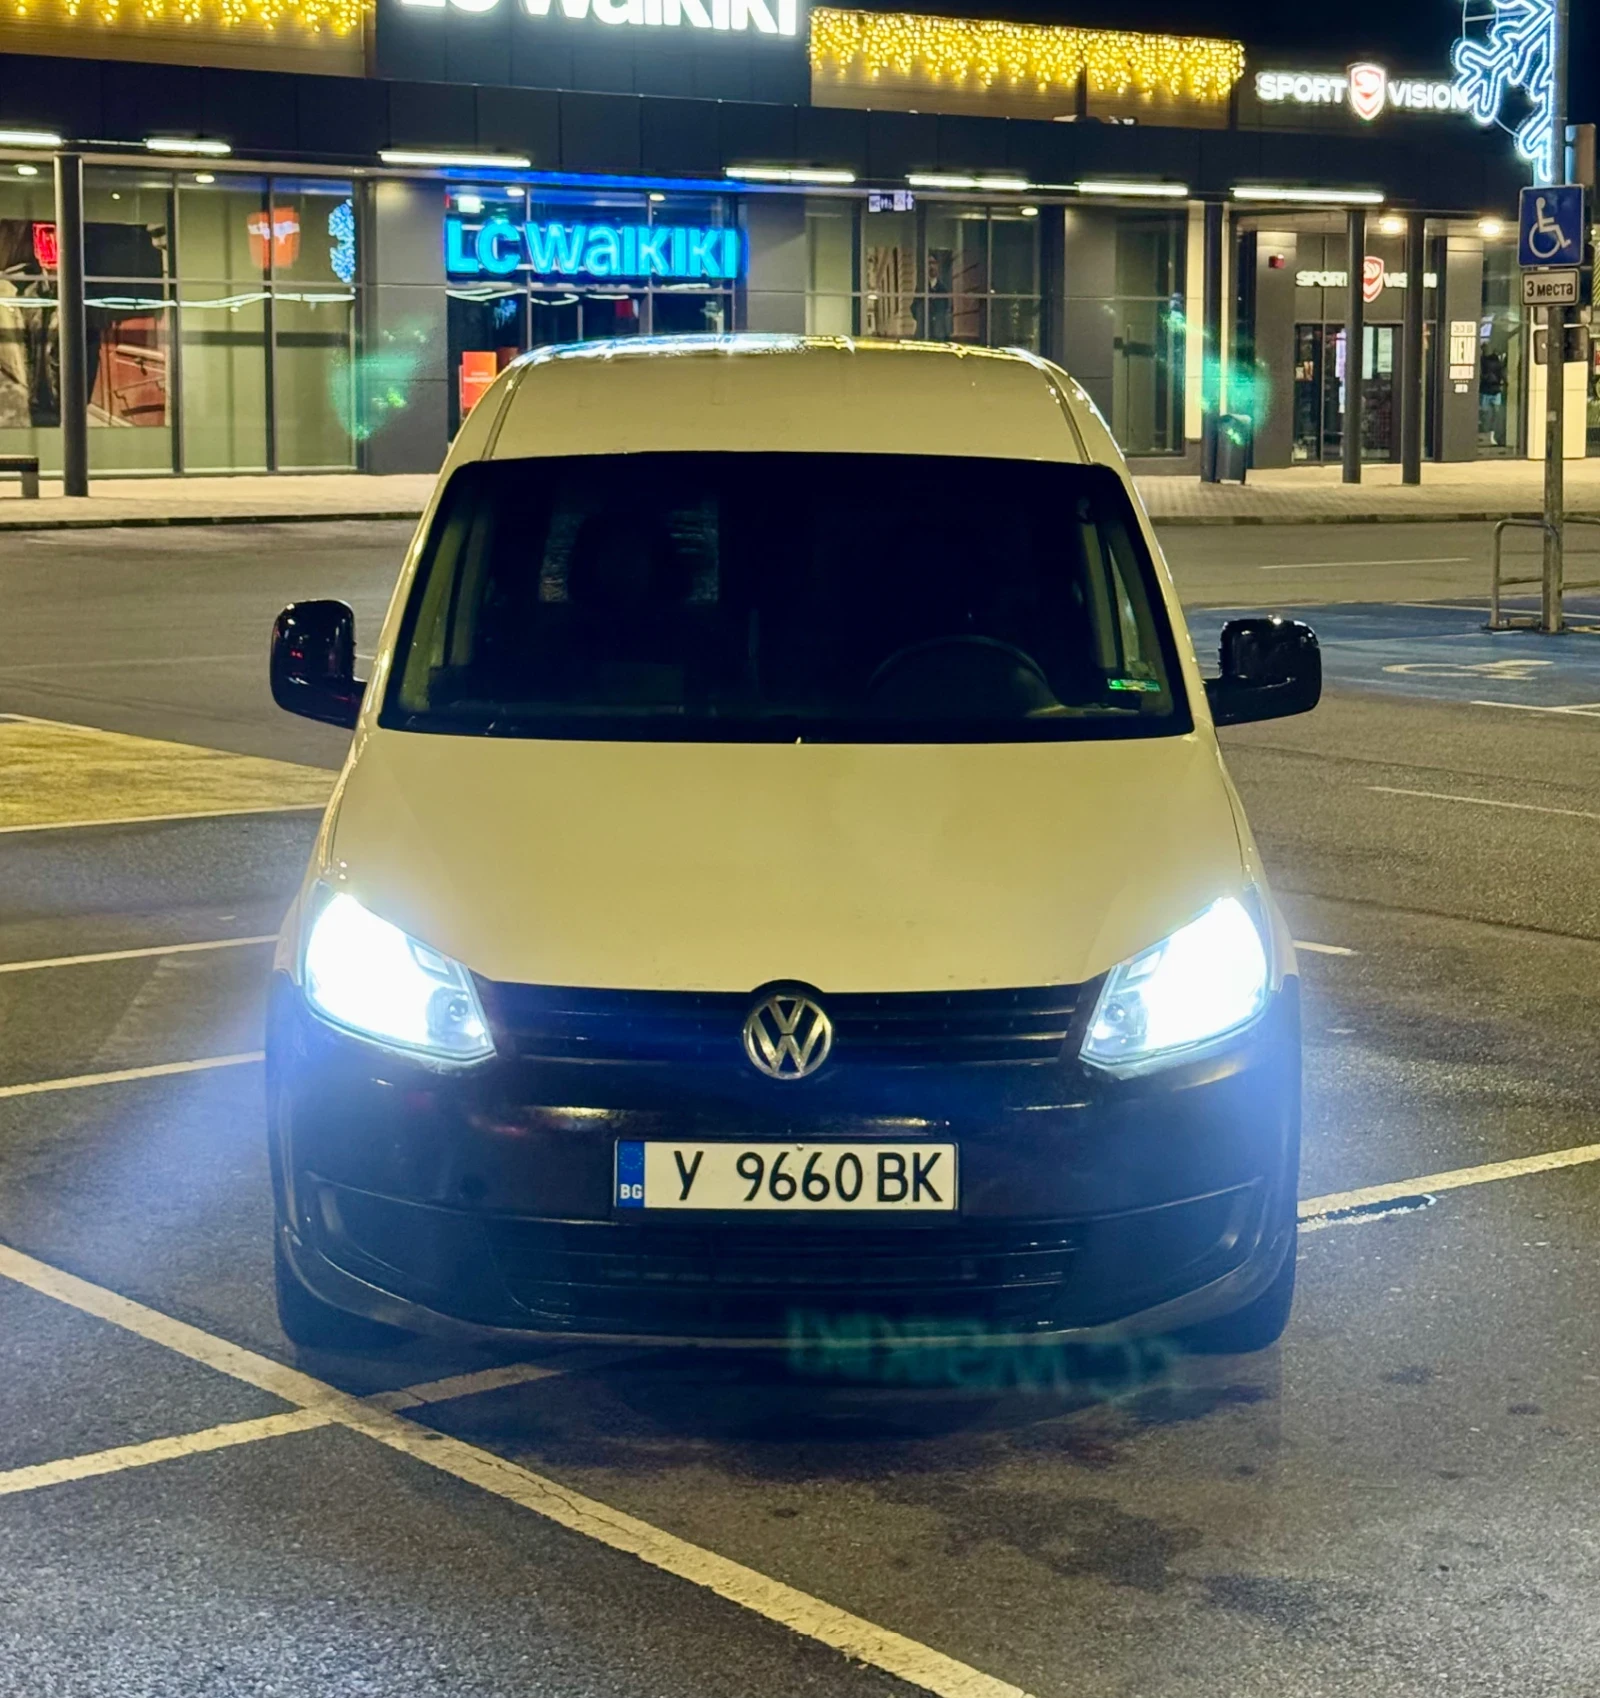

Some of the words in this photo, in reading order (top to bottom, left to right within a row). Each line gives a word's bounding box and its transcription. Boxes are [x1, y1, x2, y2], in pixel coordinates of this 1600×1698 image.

[1257, 74, 1347, 103] SPORT
[1388, 81, 1469, 109] VISION
[446, 219, 521, 273] LC
[1383, 272, 1438, 288] VISN
[1526, 280, 1535, 298] 3
[1536, 284, 1574, 297] места
[735, 1151, 864, 1202] 9660
[876, 1152, 943, 1203] BK
[620, 1183, 643, 1200] BG
